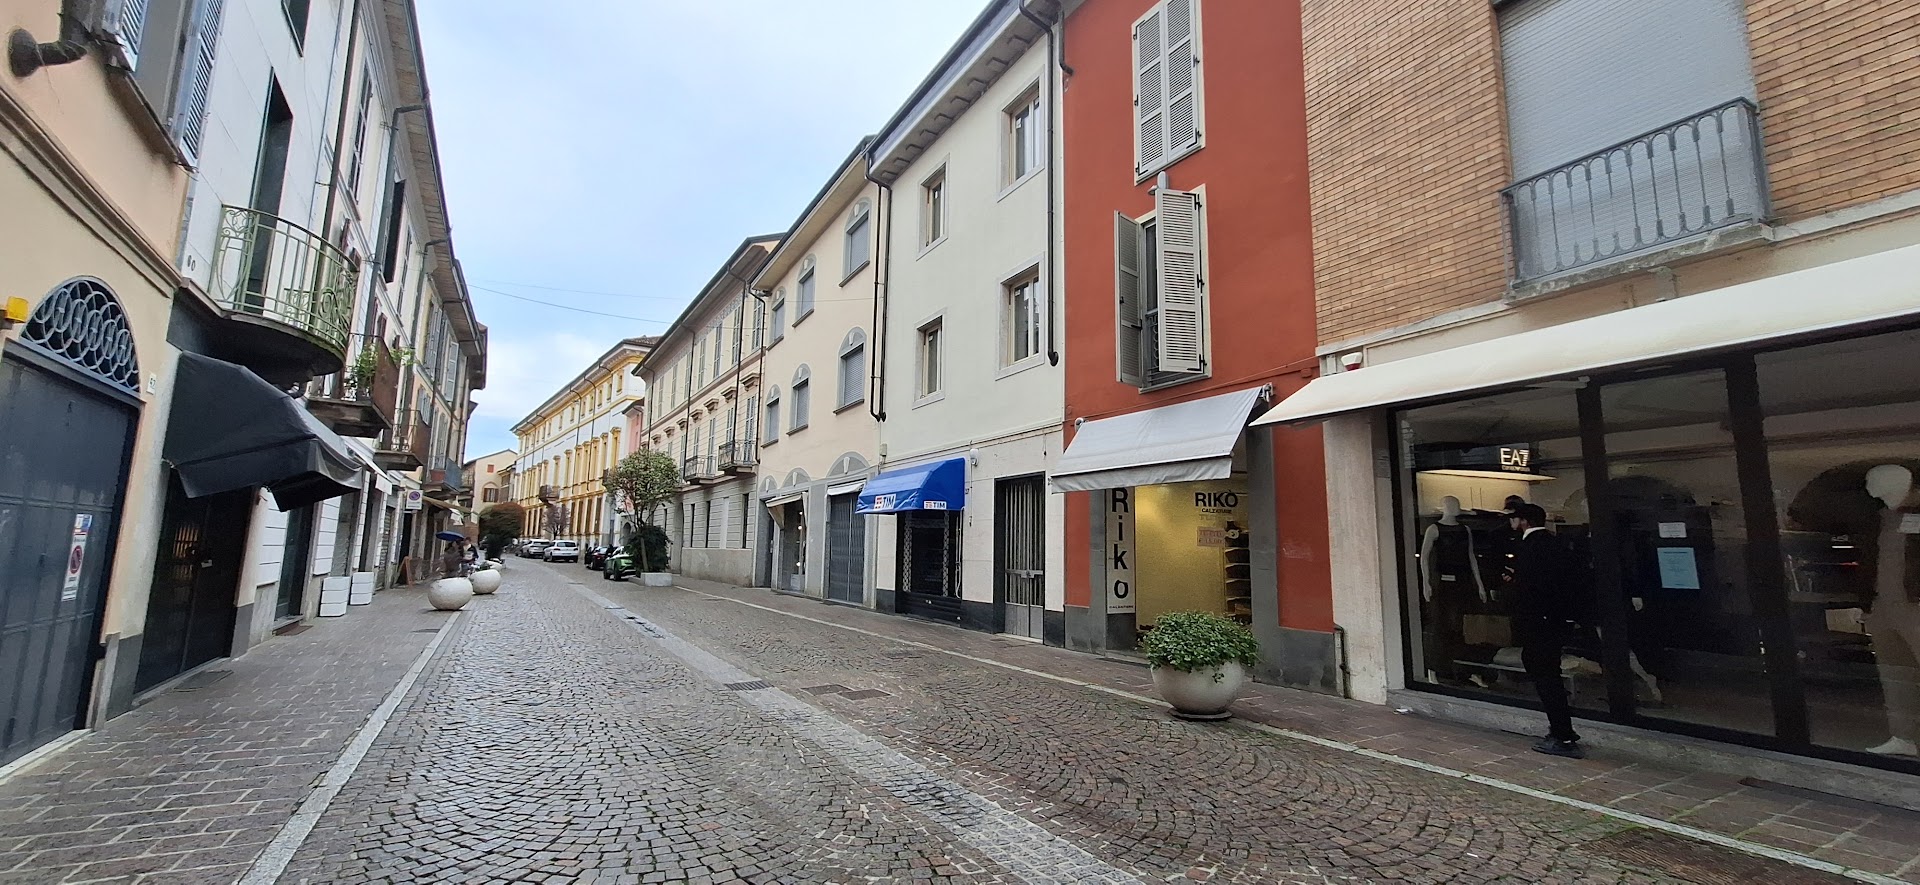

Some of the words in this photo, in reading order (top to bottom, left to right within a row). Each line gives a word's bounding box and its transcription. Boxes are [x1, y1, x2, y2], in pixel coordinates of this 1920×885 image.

[1500, 447, 1529, 466] EA7
[882, 495, 895, 509] TIM
[1195, 489, 1238, 507] RIKÒ
